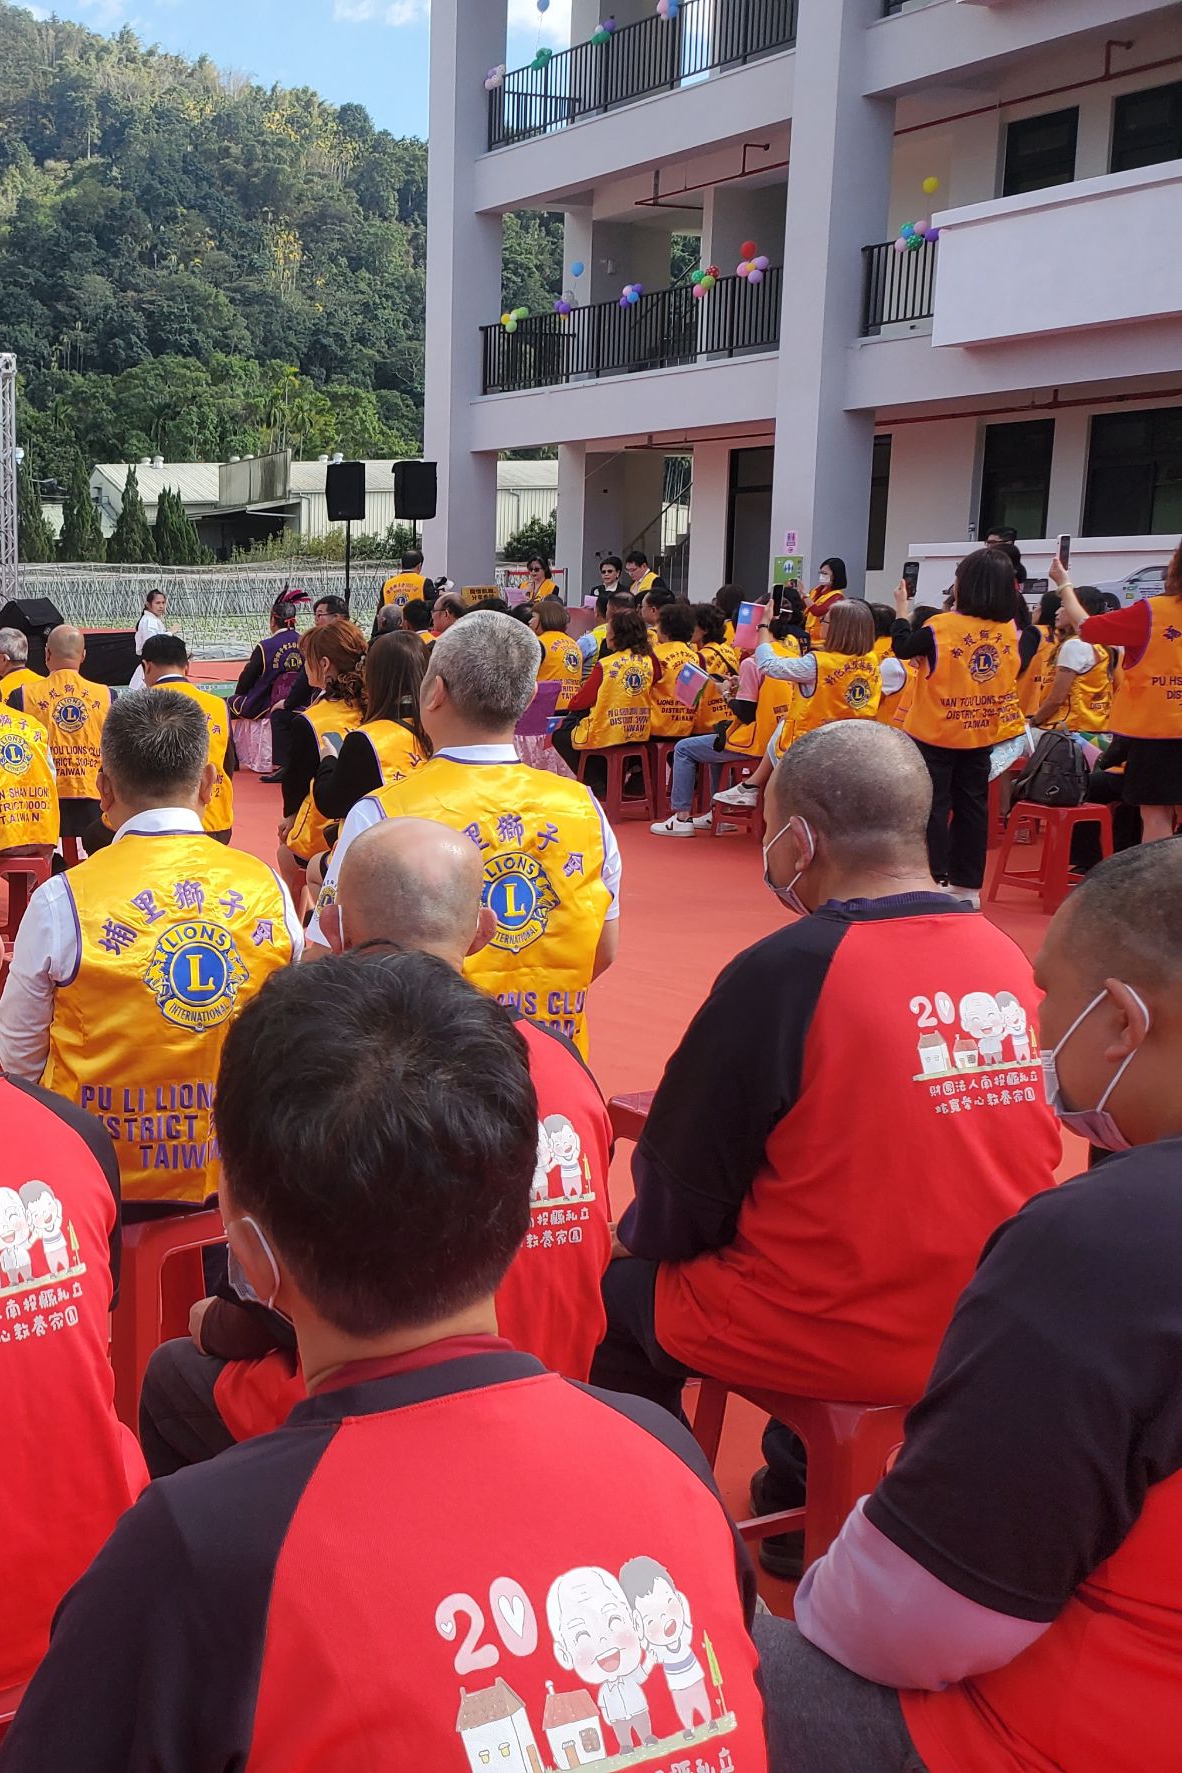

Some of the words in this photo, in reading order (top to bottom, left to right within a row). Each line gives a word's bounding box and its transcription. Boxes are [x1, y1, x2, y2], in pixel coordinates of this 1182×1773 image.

[1152, 676, 1166, 686] PU
[66, 707, 77, 721] L
[1, 735, 23, 745] LIONS
[66, 745, 87, 755] LIONS
[89, 746, 102, 757] CLU
[9, 746, 21, 761] L
[56, 768, 86, 776] TAIWAN
[29, 786, 49, 797] LION
[0, 812, 40, 825] TAIWAN
[463, 813, 584, 878] 里獅子會
[485, 857, 535, 879] LIONS
[503, 883, 527, 918] L
[98, 880, 275, 956] 埔里獅子會
[170, 926, 227, 949] LIONS
[493, 925, 538, 944] TERNATIONAL
[185, 955, 216, 992] L
[170, 1002, 230, 1023] INTERNATIONAL
[547, 990, 588, 1015] CLU
[909, 991, 955, 1028] 20
[929, 1070, 1038, 1097] 財團法人南投縣私立
[81, 1085, 113, 1111] PU
[123, 1087, 145, 1113] LI
[155, 1082, 217, 1111] LION
[529, 1206, 590, 1228] 投縣私立
[435, 1576, 538, 1675] 20
